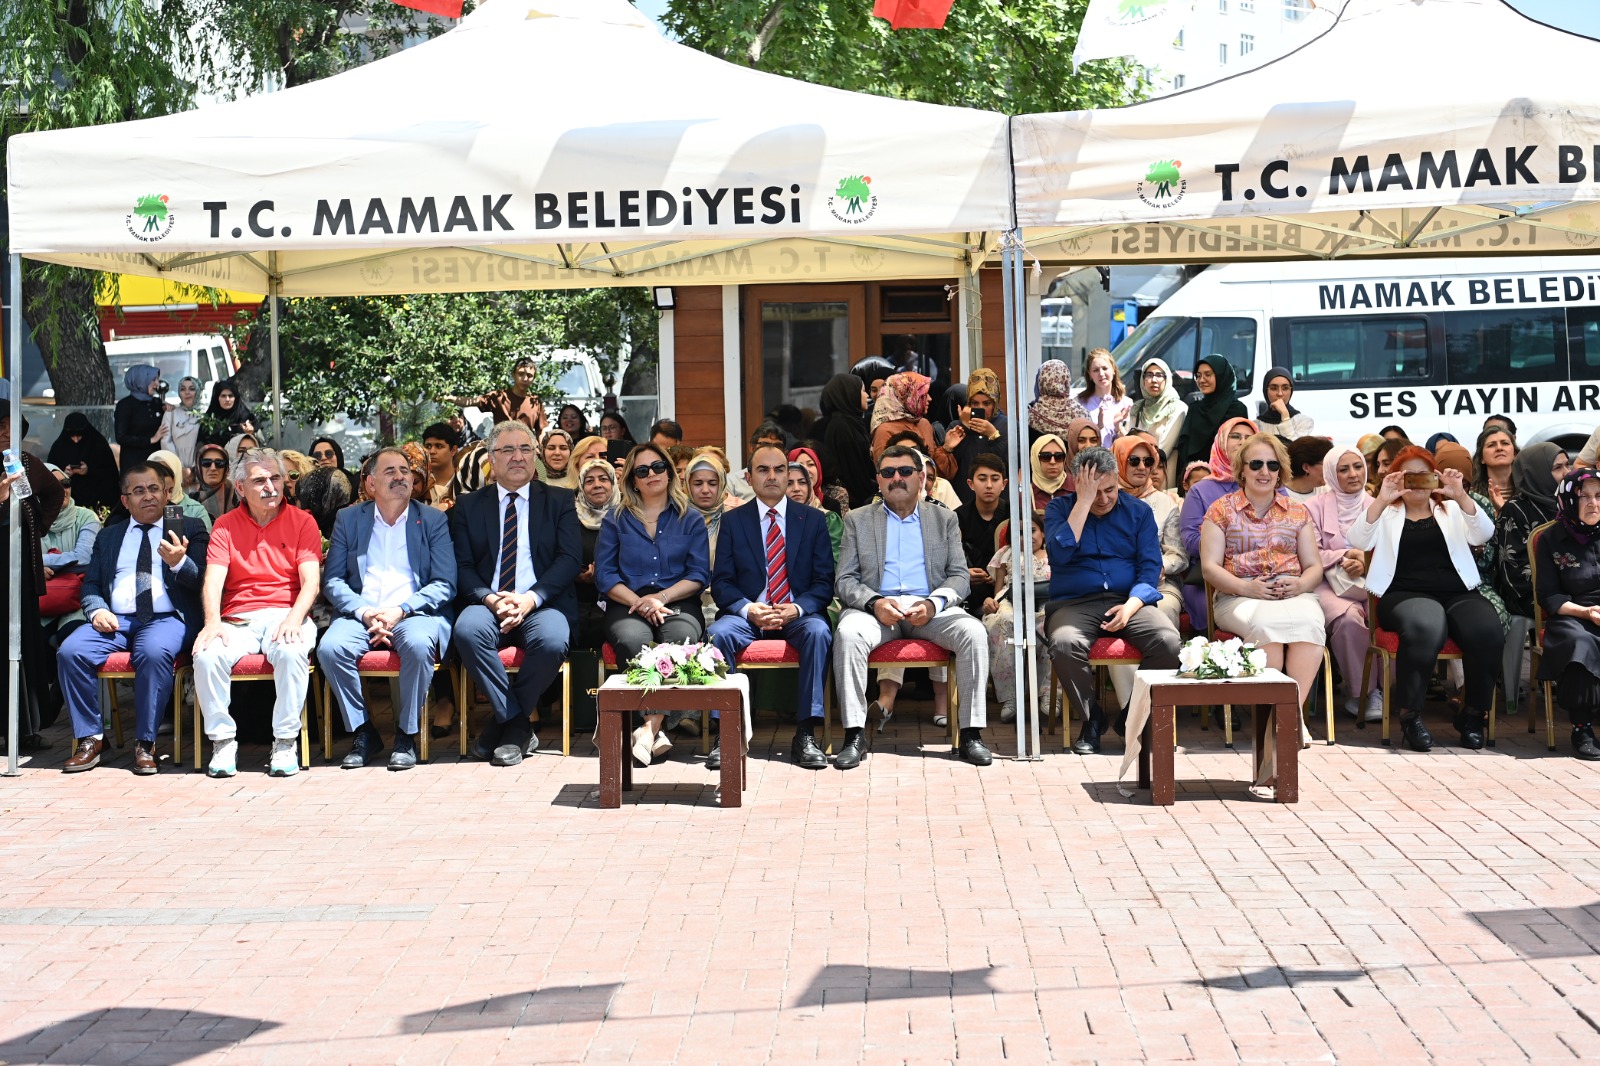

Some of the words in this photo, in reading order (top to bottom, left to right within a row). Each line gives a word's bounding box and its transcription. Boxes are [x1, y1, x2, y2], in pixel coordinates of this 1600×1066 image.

[1214, 159, 1307, 201] T.C.
[1328, 145, 1540, 195] MAMAK
[202, 200, 292, 239] T.C.
[312, 194, 516, 236] MAMAK
[1139, 194, 1161, 209] MAMAK
[1319, 280, 1456, 310] MAMAK
[1468, 275, 1600, 305] BELEDi
[1350, 390, 1418, 419] SES
[1430, 386, 1539, 416] YAYIN
